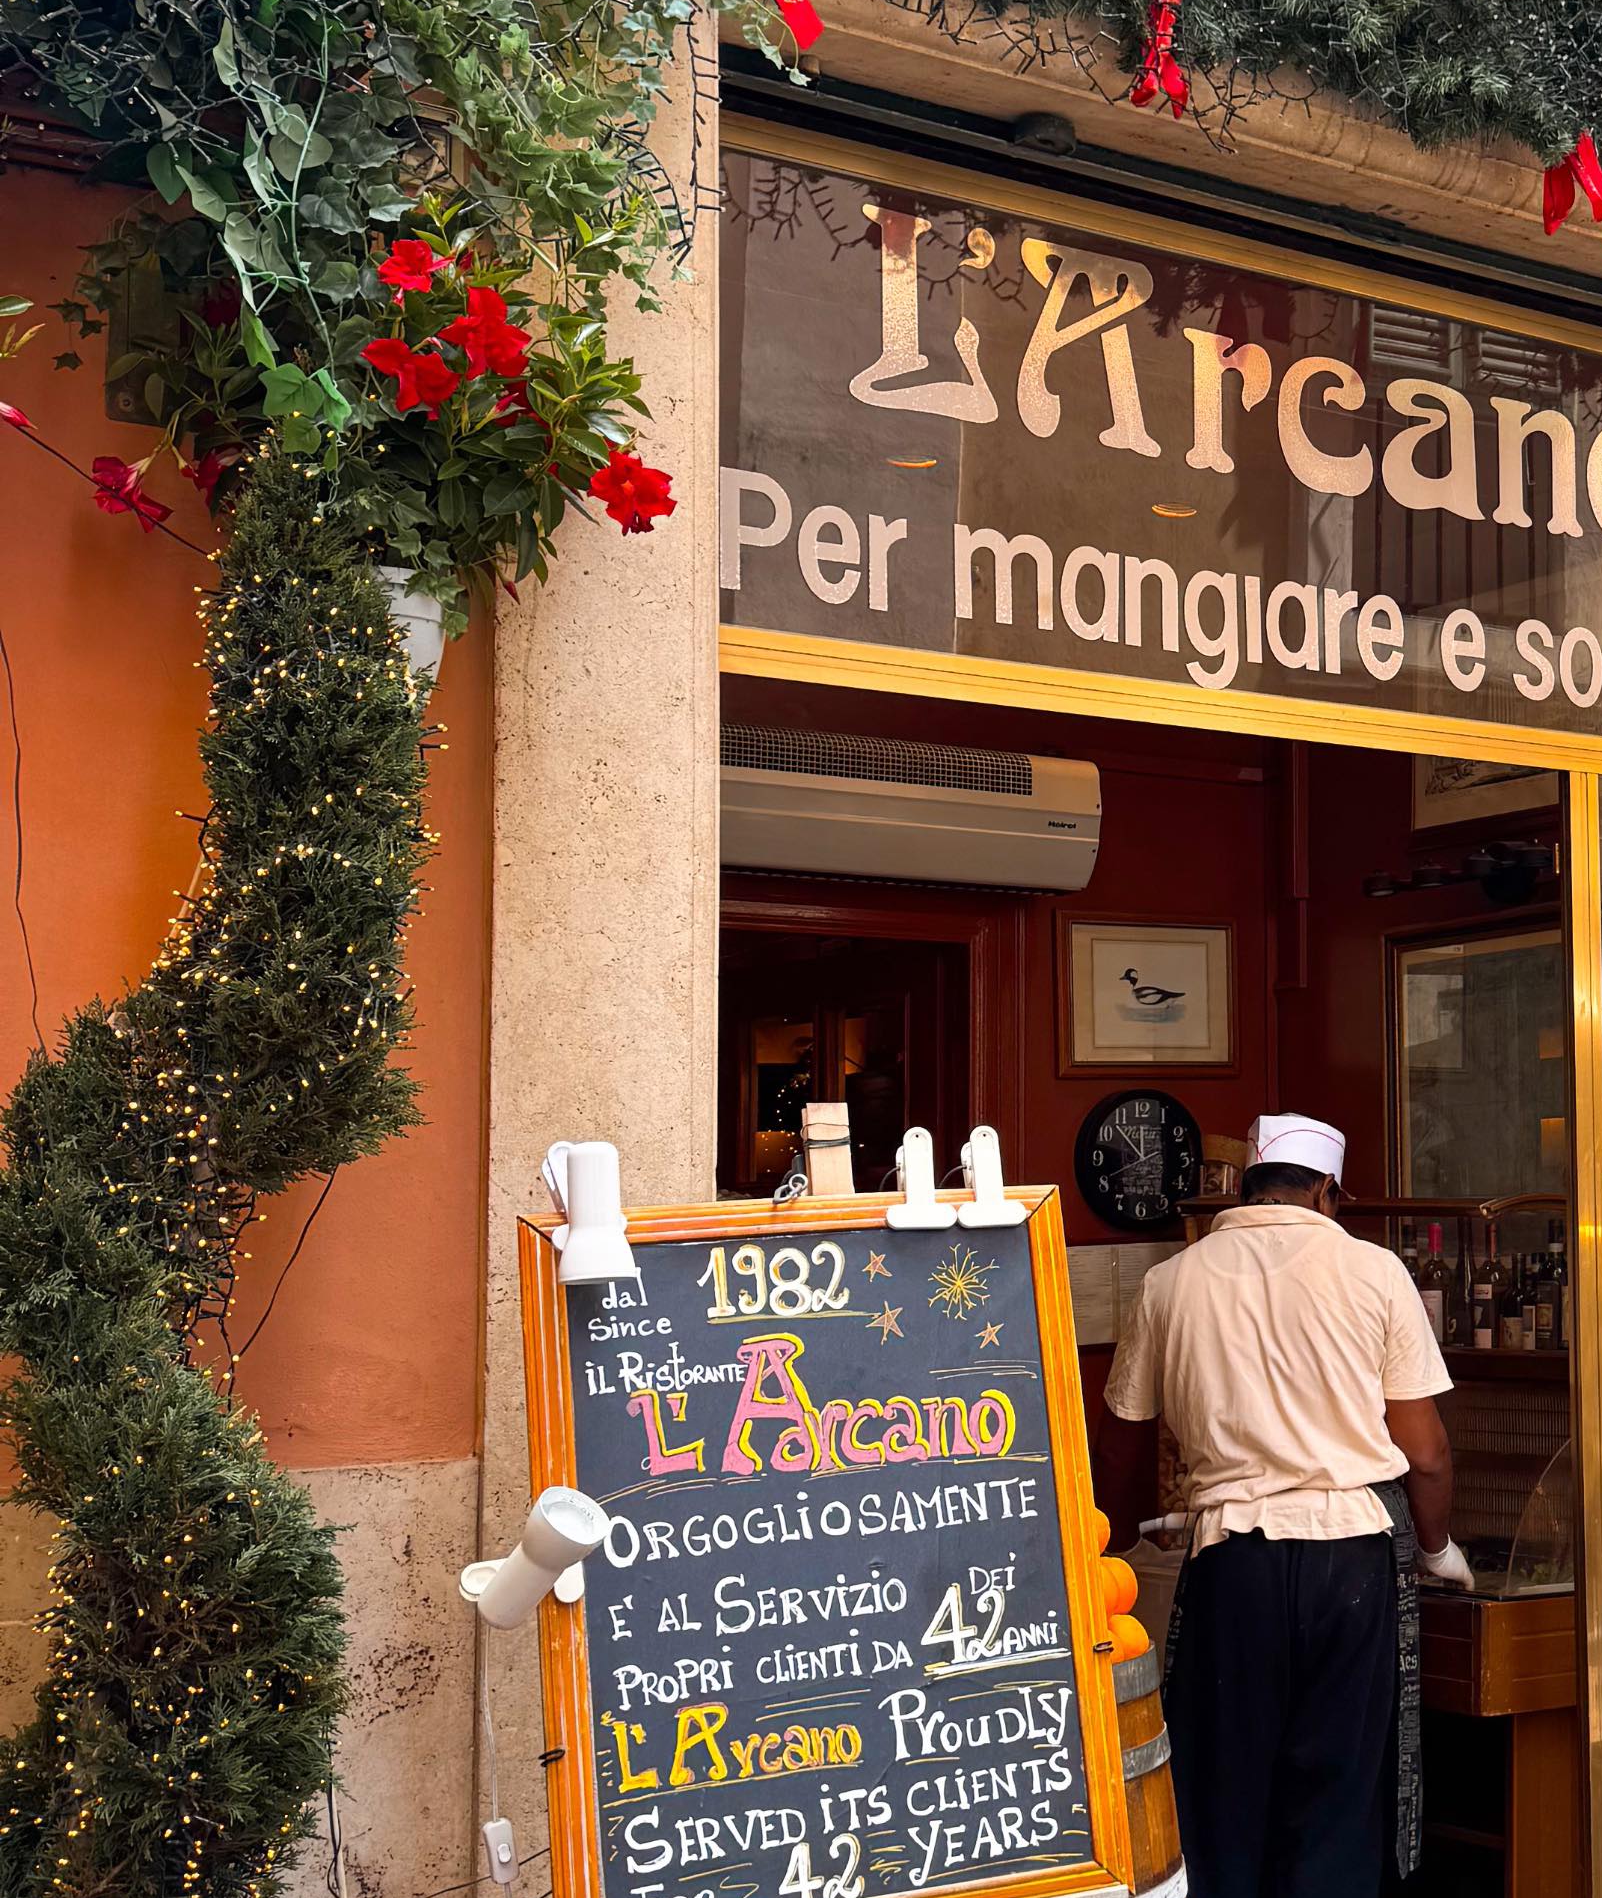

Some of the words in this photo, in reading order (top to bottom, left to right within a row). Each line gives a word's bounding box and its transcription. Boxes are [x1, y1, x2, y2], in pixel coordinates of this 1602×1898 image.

[719, 467, 908, 612] Per
[1440, 608, 1486, 692] e
[1115, 1107, 1127, 1124] 11
[1134, 1101, 1150, 1118] 12
[1099, 1126, 1113, 1142] 10
[1173, 1126, 1184, 1142] 2
[1092, 1150, 1104, 1167] 9
[1179, 1152, 1190, 1168] 3
[1098, 1175, 1110, 1193] 8
[1114, 1194, 1125, 1211] 7
[1135, 1201, 1146, 1218] 6
[601, 1267, 648, 1309] dal
[697, 1241, 850, 1318] 1982
[587, 1316, 673, 1342] Since
[658, 1593, 702, 1633] AL
[872, 1640, 914, 1674] DA
[920, 1582, 1006, 1665] 42
[624, 1806, 806, 1875] SERVED
[908, 1801, 1060, 1887] YEARS
